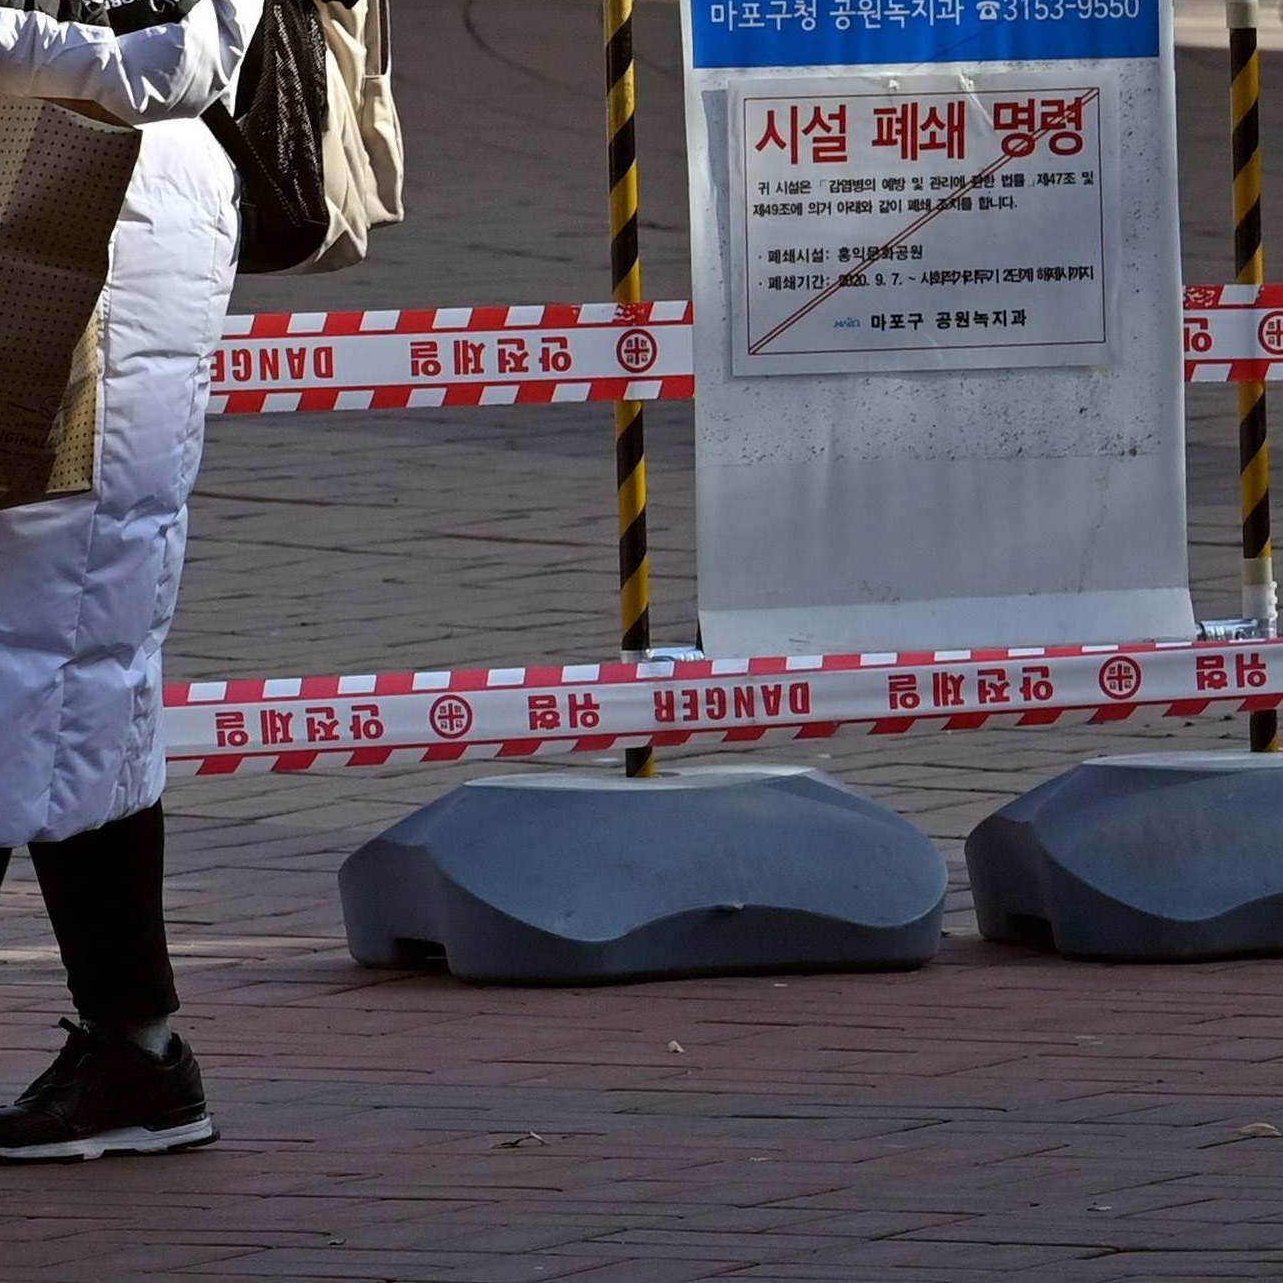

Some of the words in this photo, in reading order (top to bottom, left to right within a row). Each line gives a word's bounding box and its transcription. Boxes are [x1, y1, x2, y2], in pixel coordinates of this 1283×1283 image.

[755, 103, 848, 165] 시설
[871, 99, 966, 160] 폐쇄
[992, 96, 1084, 158] 명령
[758, 181, 770, 195] 귀
[775, 180, 812, 195] 시설은
[882, 177, 905, 192] 예방
[911, 177, 924, 191] 및
[929, 175, 966, 190] 관리에
[1082, 171, 1094, 185] 및
[808, 201, 832, 215] 의거
[837, 201, 873, 214] 아래와
[879, 199, 902, 214] 같이
[979, 196, 1017, 210] 합니다.
[767, 248, 829, 265] 폐쇄시설:
[837, 244, 923, 263] 홍익문화공원
[768, 275, 830, 291] 폐쇄기간:
[871, 313, 924, 331] 마포구
[936, 309, 1027, 329] 공원녹지과
[210, 345, 334, 383] DANGE
[409, 335, 572, 377] 안전제일
[888, 665, 1054, 710] 안전제일
[1196, 653, 1267, 691] 위험
[528, 692, 602, 731] 위험
[653, 681, 810, 724] DANGER
[215, 704, 385, 748] 안전제일
